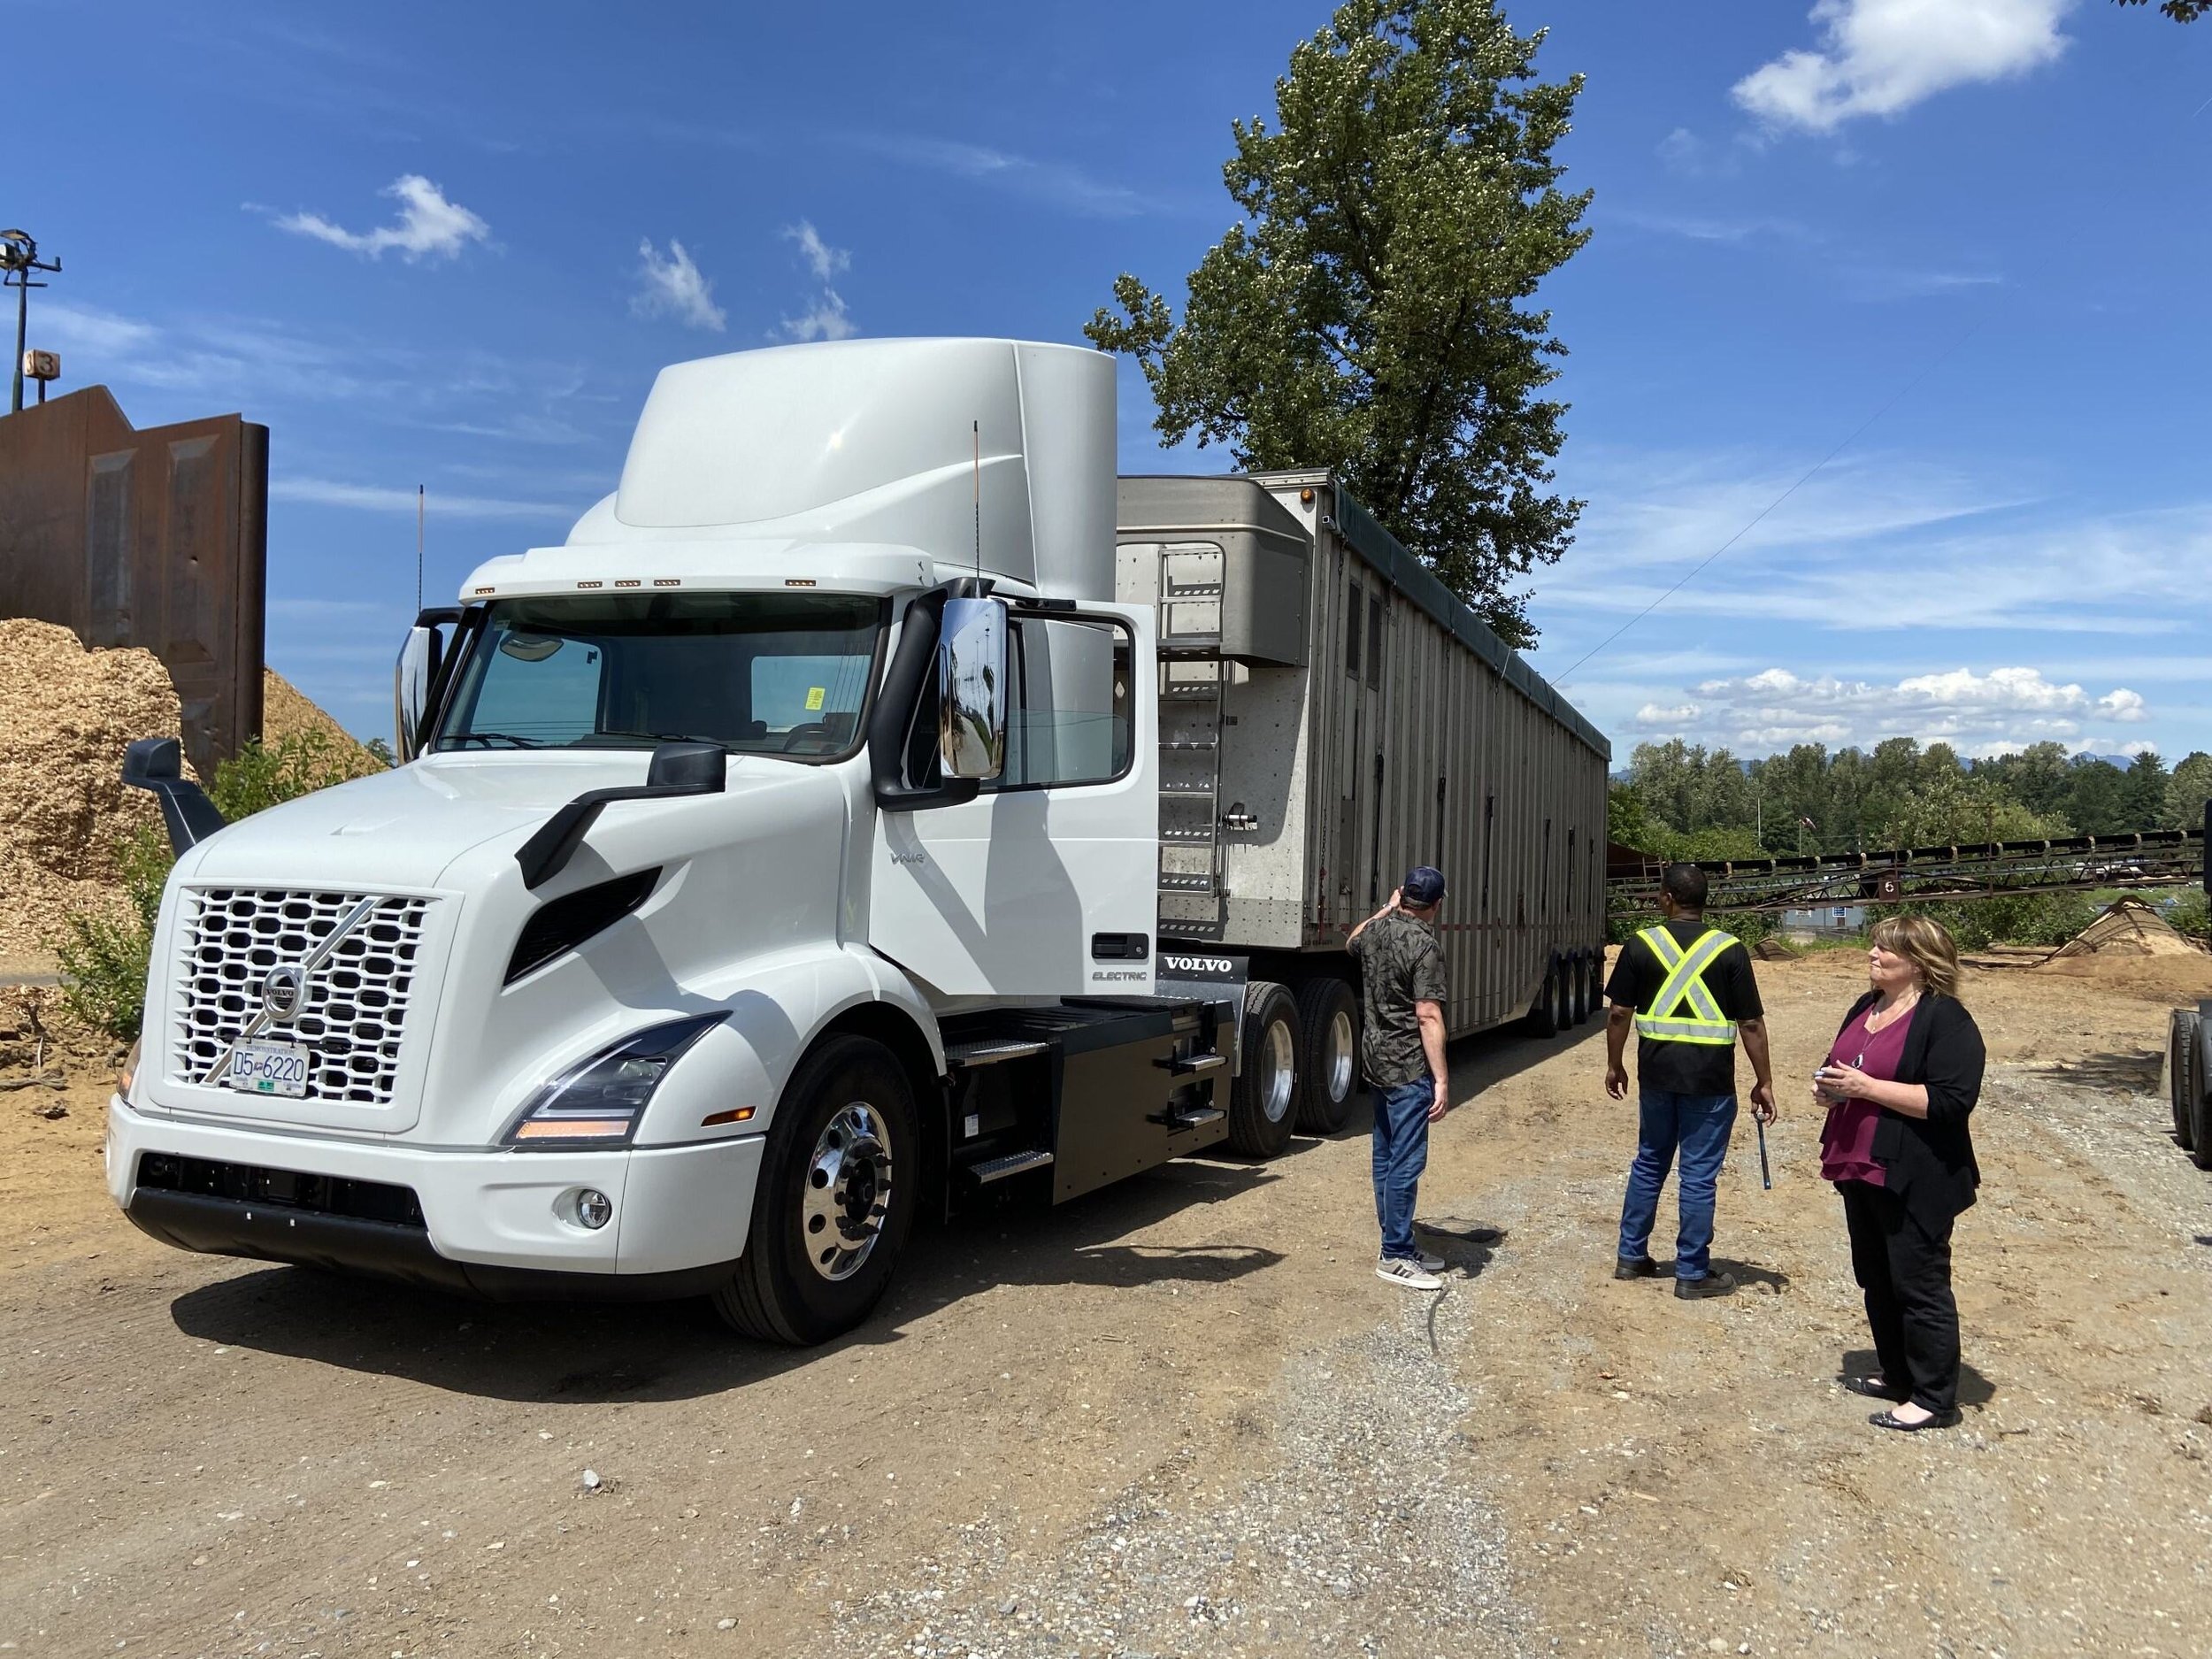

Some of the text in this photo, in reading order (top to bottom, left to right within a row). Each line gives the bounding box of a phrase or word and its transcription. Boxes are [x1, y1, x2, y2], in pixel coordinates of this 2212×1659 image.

[38, 354, 53, 373] 3
[1885, 881, 1894, 893] 6
[1164, 956, 1233, 972] VOLVO
[1092, 972, 1147, 981] ELECTRIC
